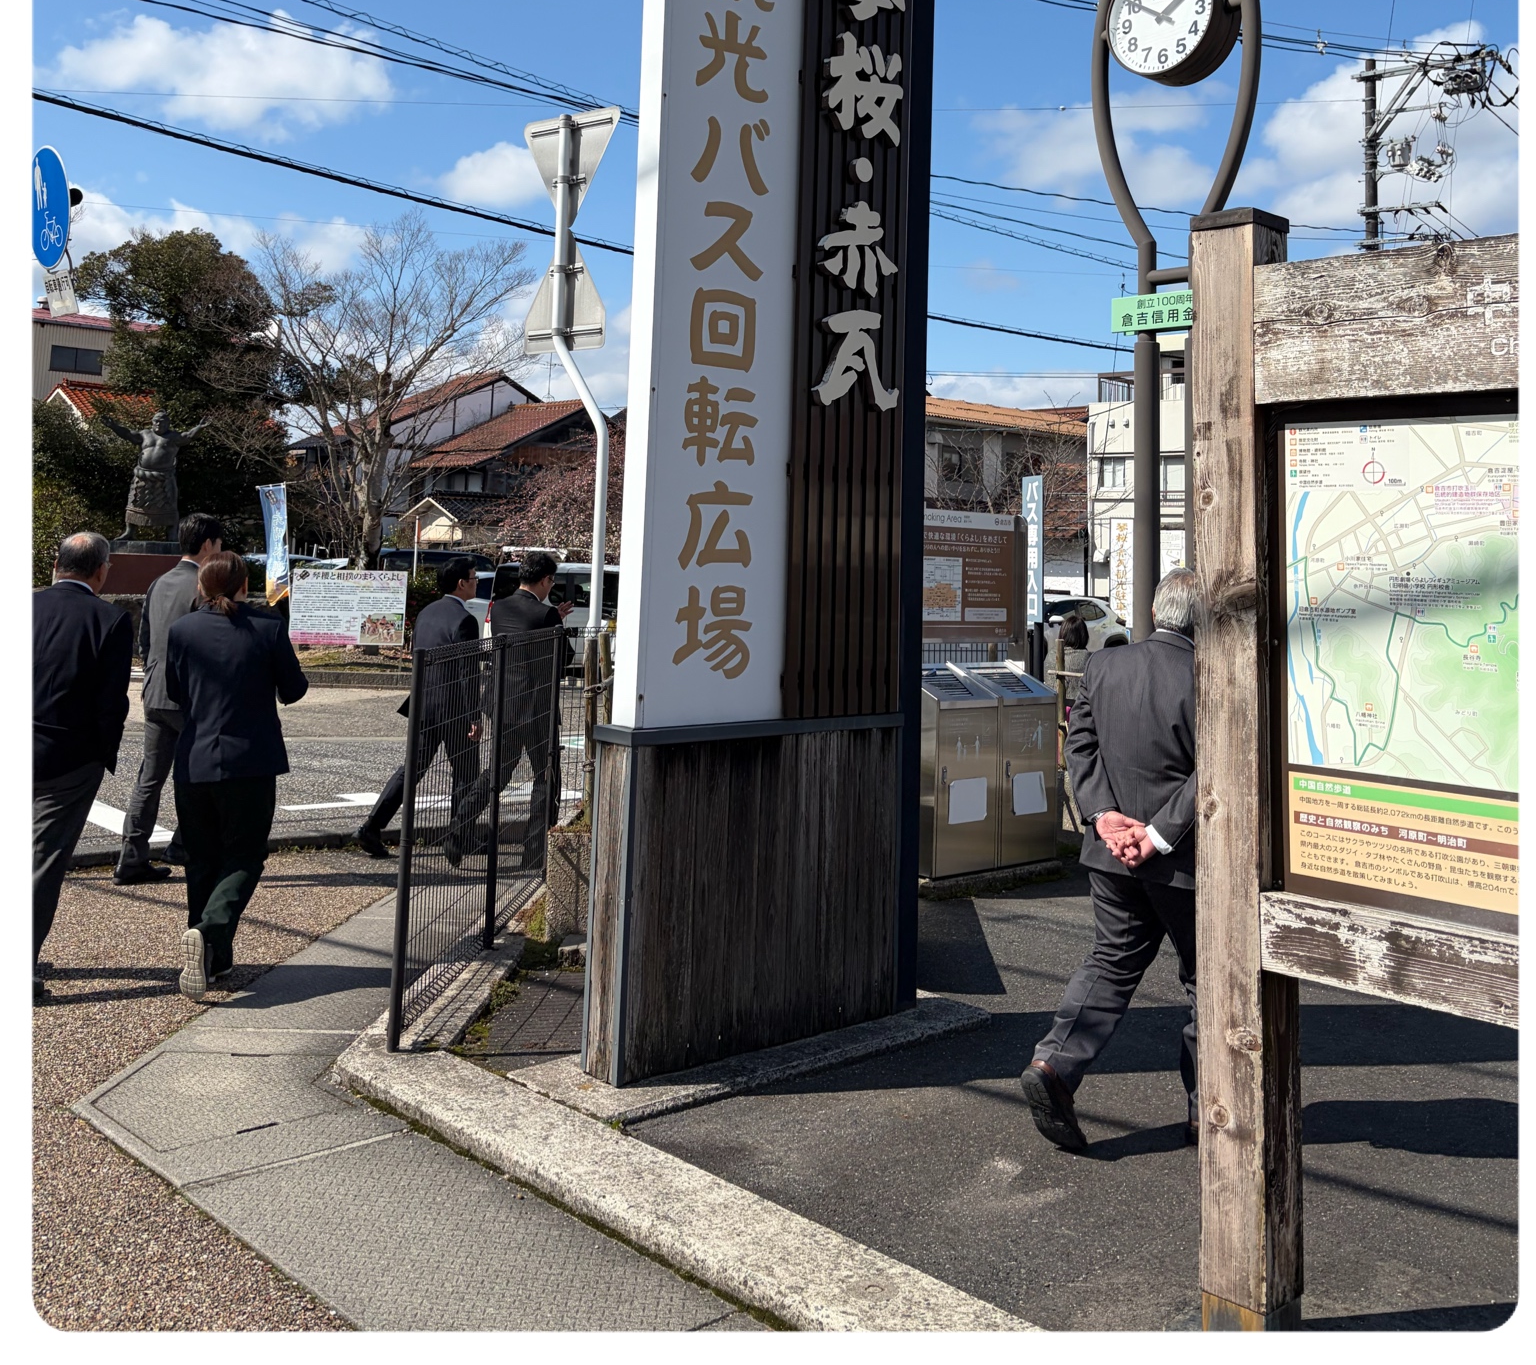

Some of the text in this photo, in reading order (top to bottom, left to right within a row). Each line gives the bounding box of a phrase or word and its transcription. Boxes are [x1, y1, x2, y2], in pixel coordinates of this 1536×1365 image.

[1195, 0, 1205, 14] 3
[1122, 19, 1132, 34] 9
[1188, 20, 1199, 36] 4
[1128, 37, 1138, 52] 8
[1176, 38, 1186, 54] 5
[1142, 47, 1152, 63] 7
[1158, 49, 1168, 64] 6
[1137, 294, 1193, 309] 創立100周年
[946, 514, 962, 523] Area
[1026, 480, 1038, 616] バス専用入口
[378, 571, 403, 581] くらよし
[1299, 779, 1352, 795] 中国自然歩道
[1299, 812, 1389, 836] 歴史と自然観察のみち
[1300, 851, 1349, 866] こともできます。
[1300, 839, 1519, 885] 県内最大のスダジイ・タブ林やたくさんの野鳥・昆虫たちを観察する
[1300, 861, 1418, 890] 身近な自然歩道を散策してみましょう。
